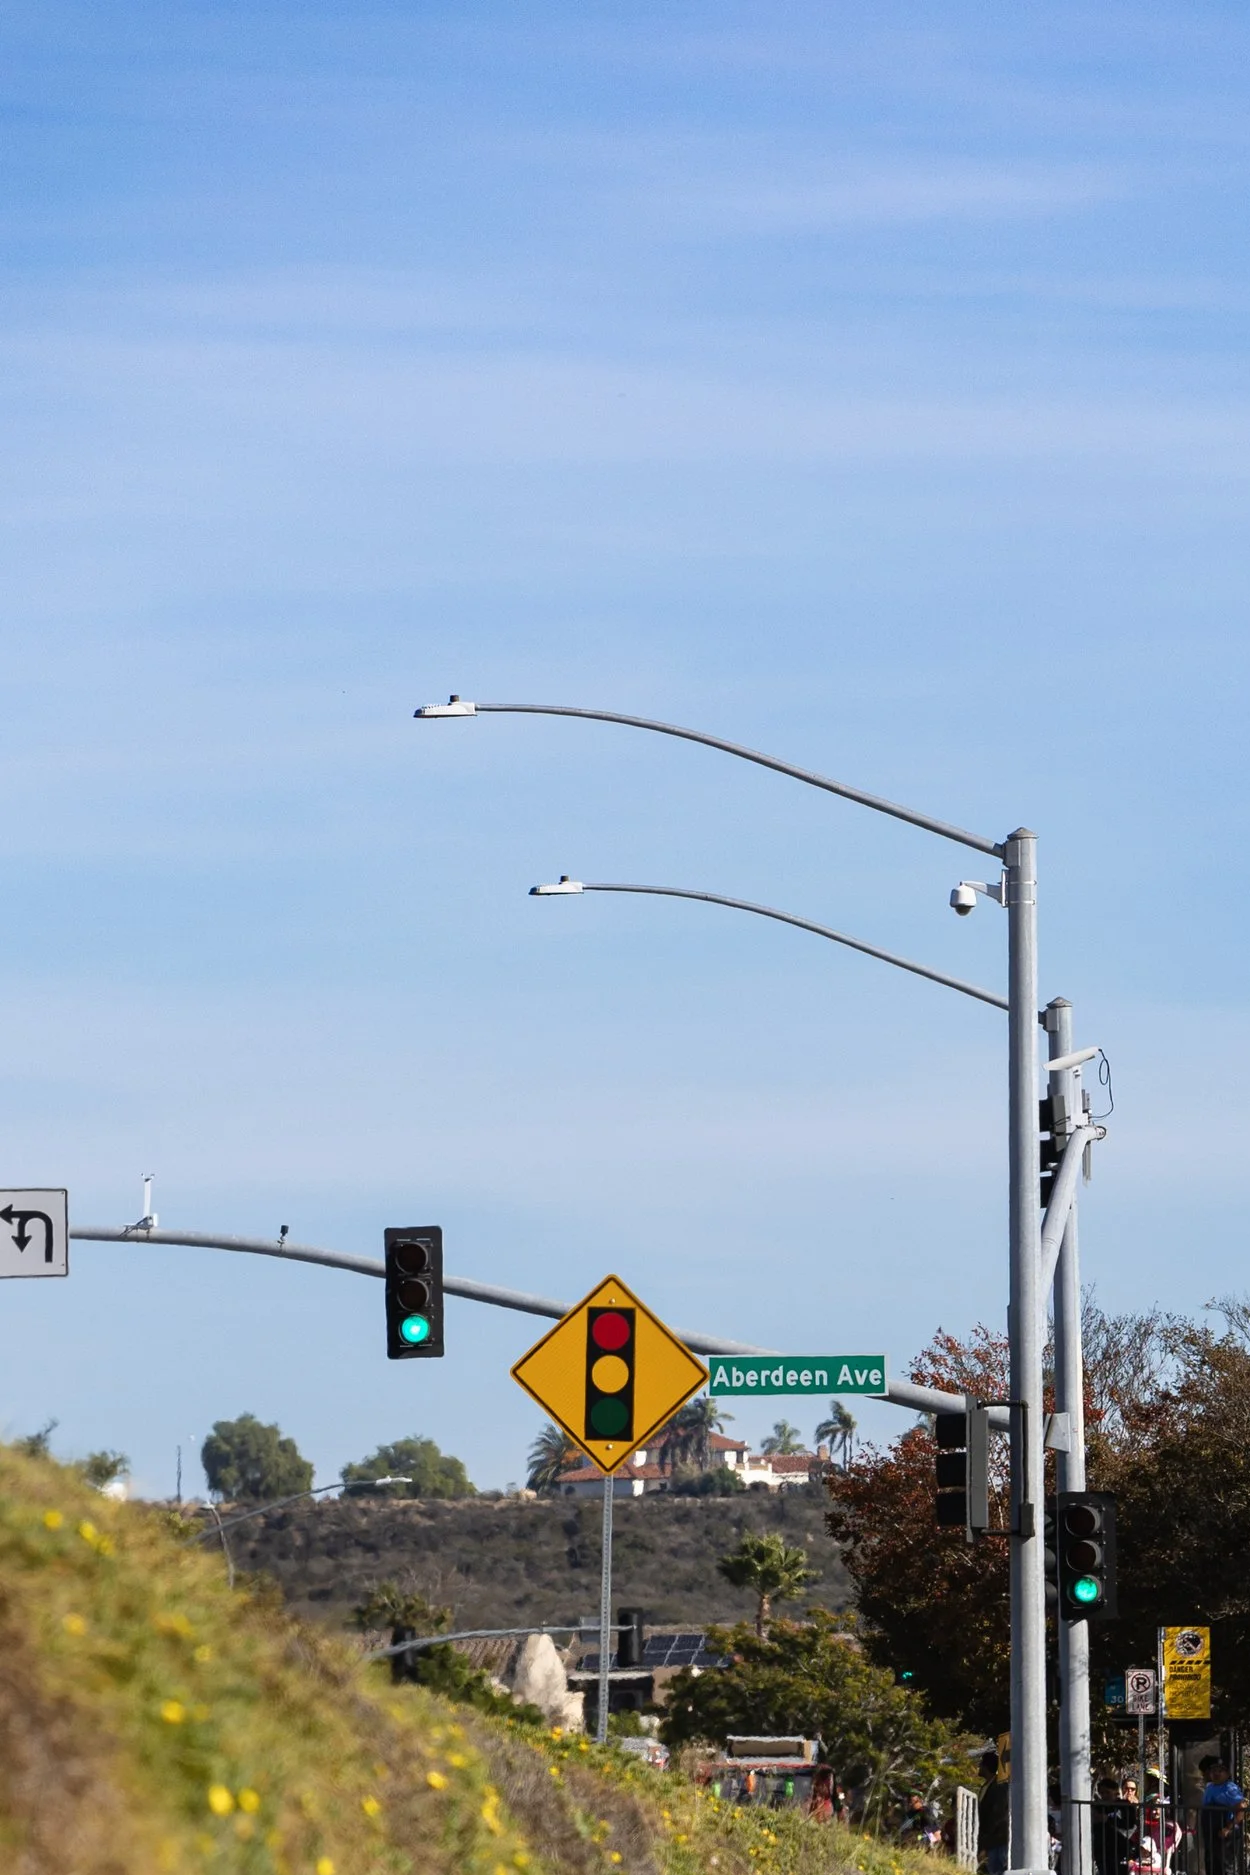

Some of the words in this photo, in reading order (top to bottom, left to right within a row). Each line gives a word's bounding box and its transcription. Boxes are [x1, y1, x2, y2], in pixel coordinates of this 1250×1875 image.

[712, 1365, 828, 1387] Aberdeen
[837, 1364, 882, 1386] Ave
[1110, 1695, 1124, 1704] 30
[1132, 1694, 1149, 1702] BIKE
[1132, 1703, 1149, 1711] LANE
